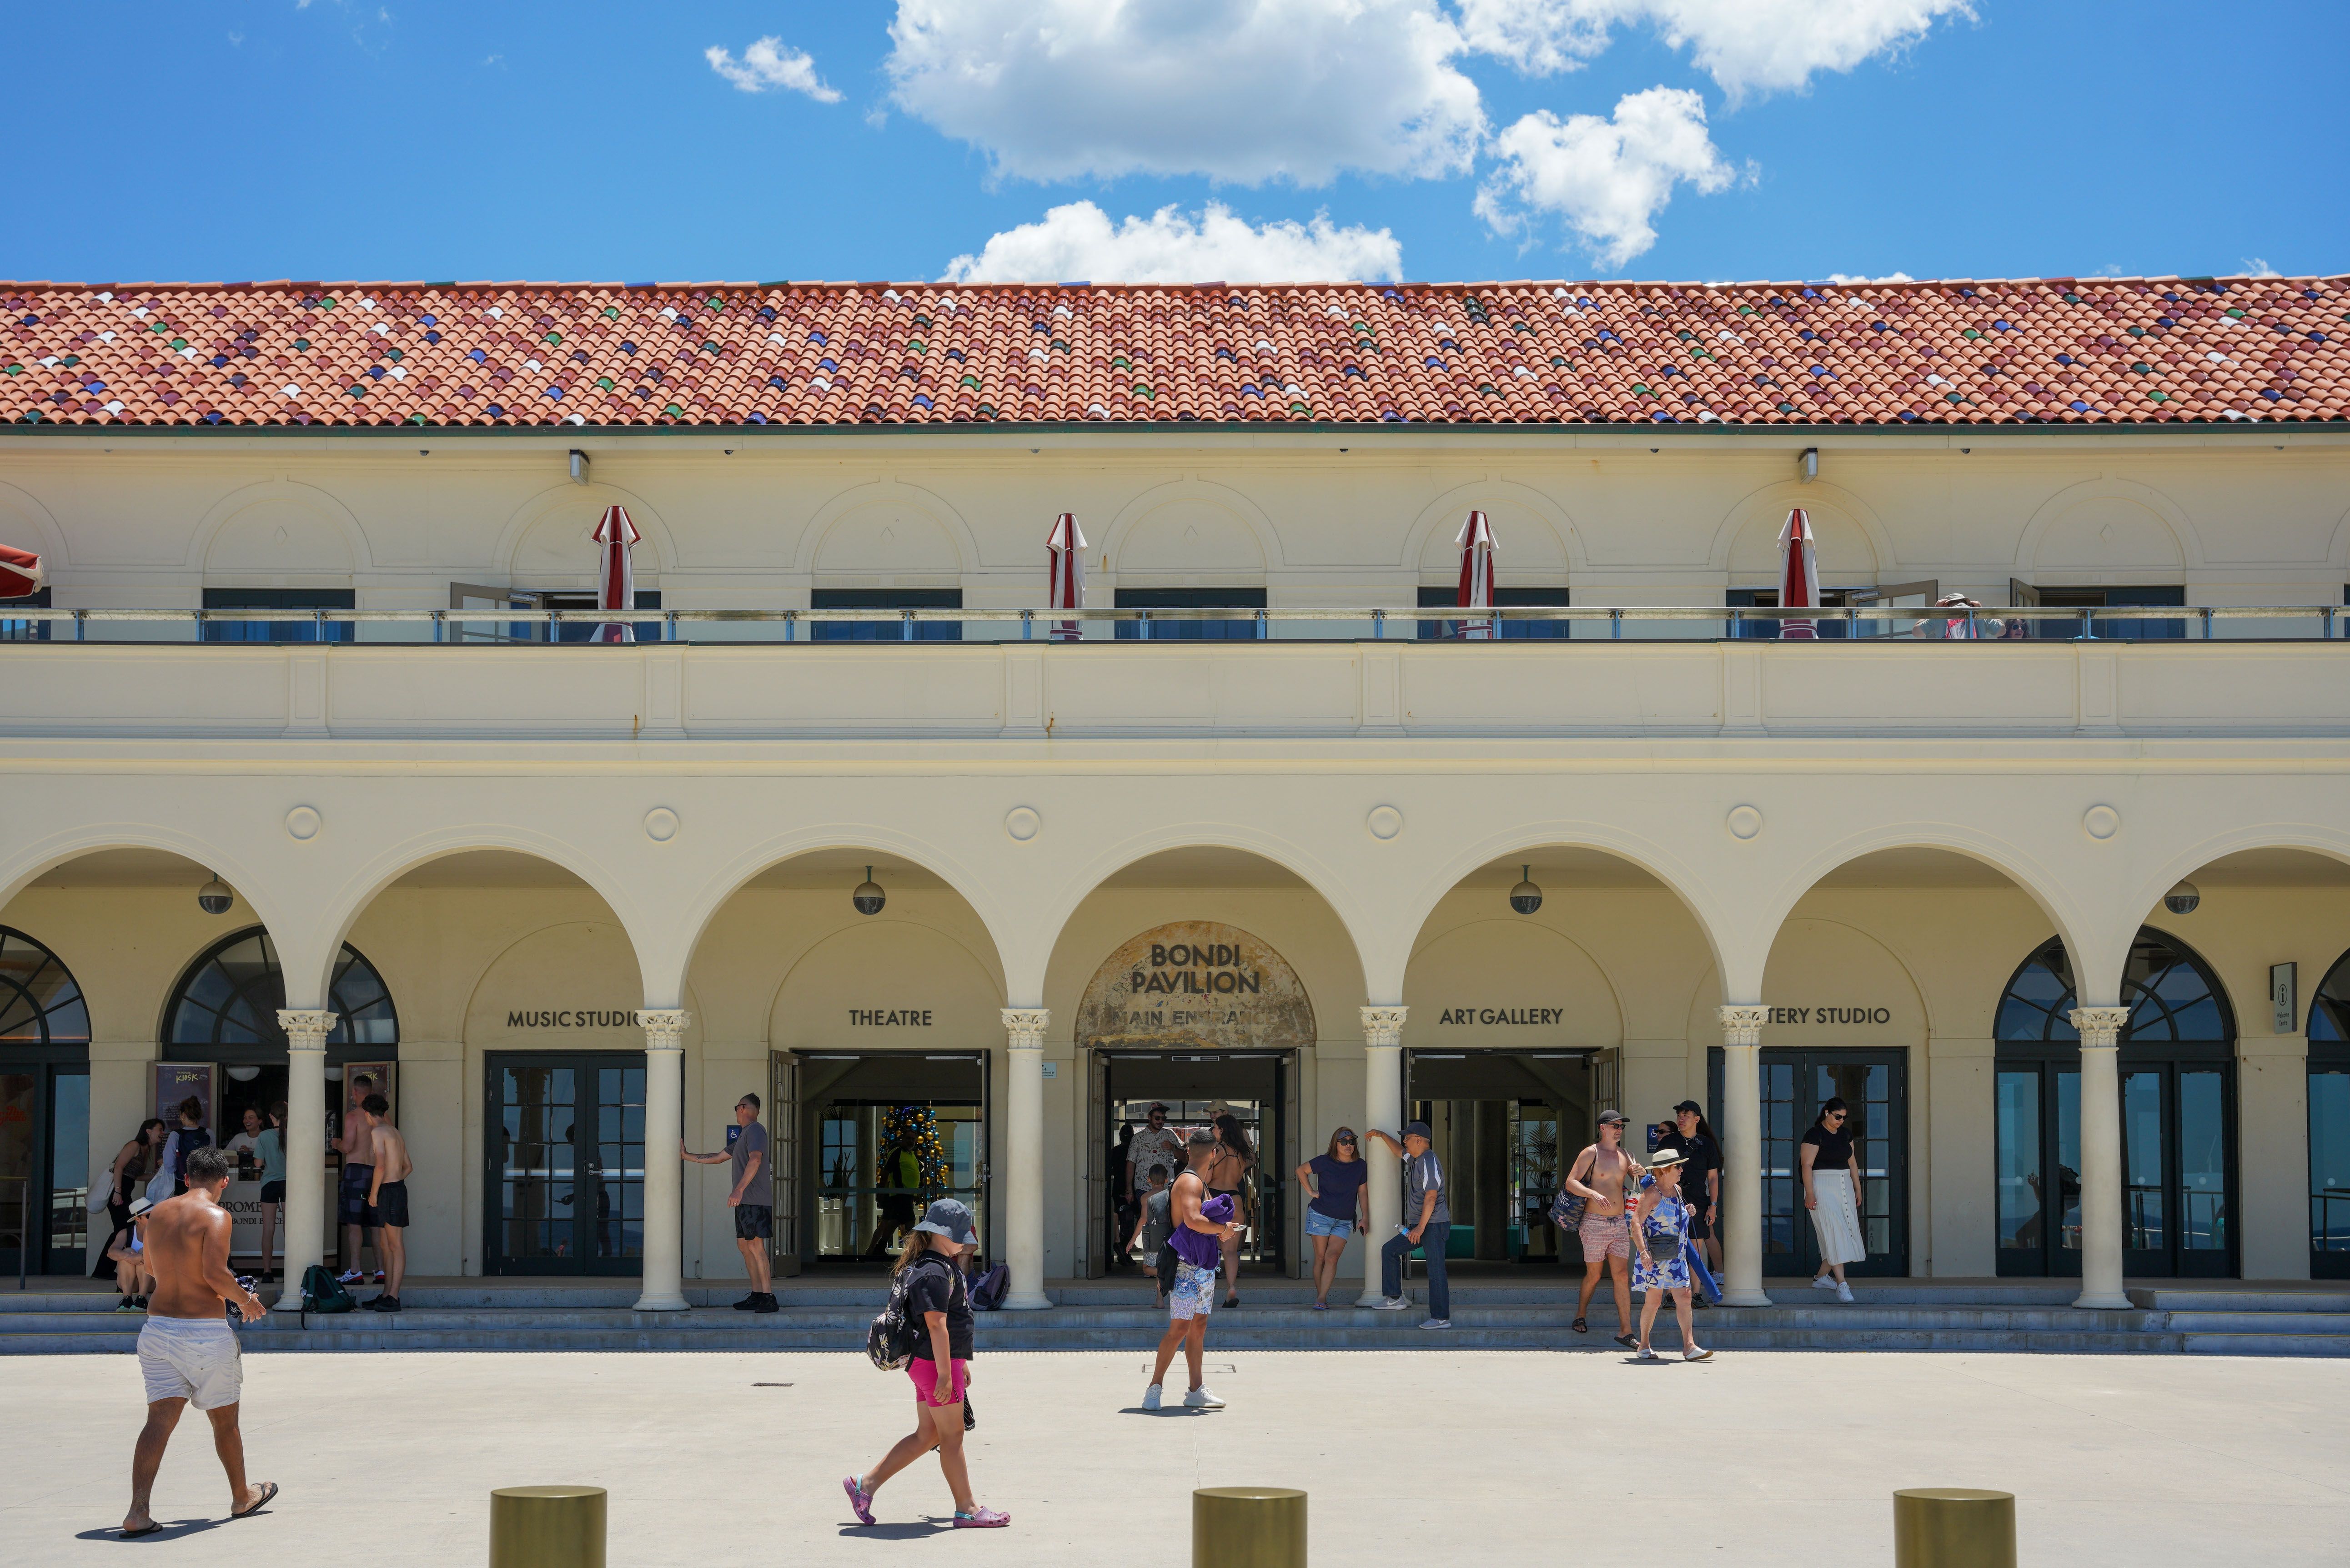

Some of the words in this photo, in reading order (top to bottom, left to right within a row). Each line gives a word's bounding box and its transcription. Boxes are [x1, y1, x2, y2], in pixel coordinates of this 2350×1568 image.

[1151, 944, 1240, 966] BONDI
[1132, 971, 1259, 994] PAVILION
[507, 1010, 570, 1027] MUSIC
[849, 1010, 931, 1025] THEATRE
[1112, 1010, 1163, 1025] MAIN
[1439, 1008, 1476, 1025] ART
[1480, 1008, 1563, 1025] GALLERY
[1767, 1008, 1810, 1024] TERY
[1816, 1008, 1890, 1024] STUDIO
[176, 1074, 198, 1084] KIOSK
